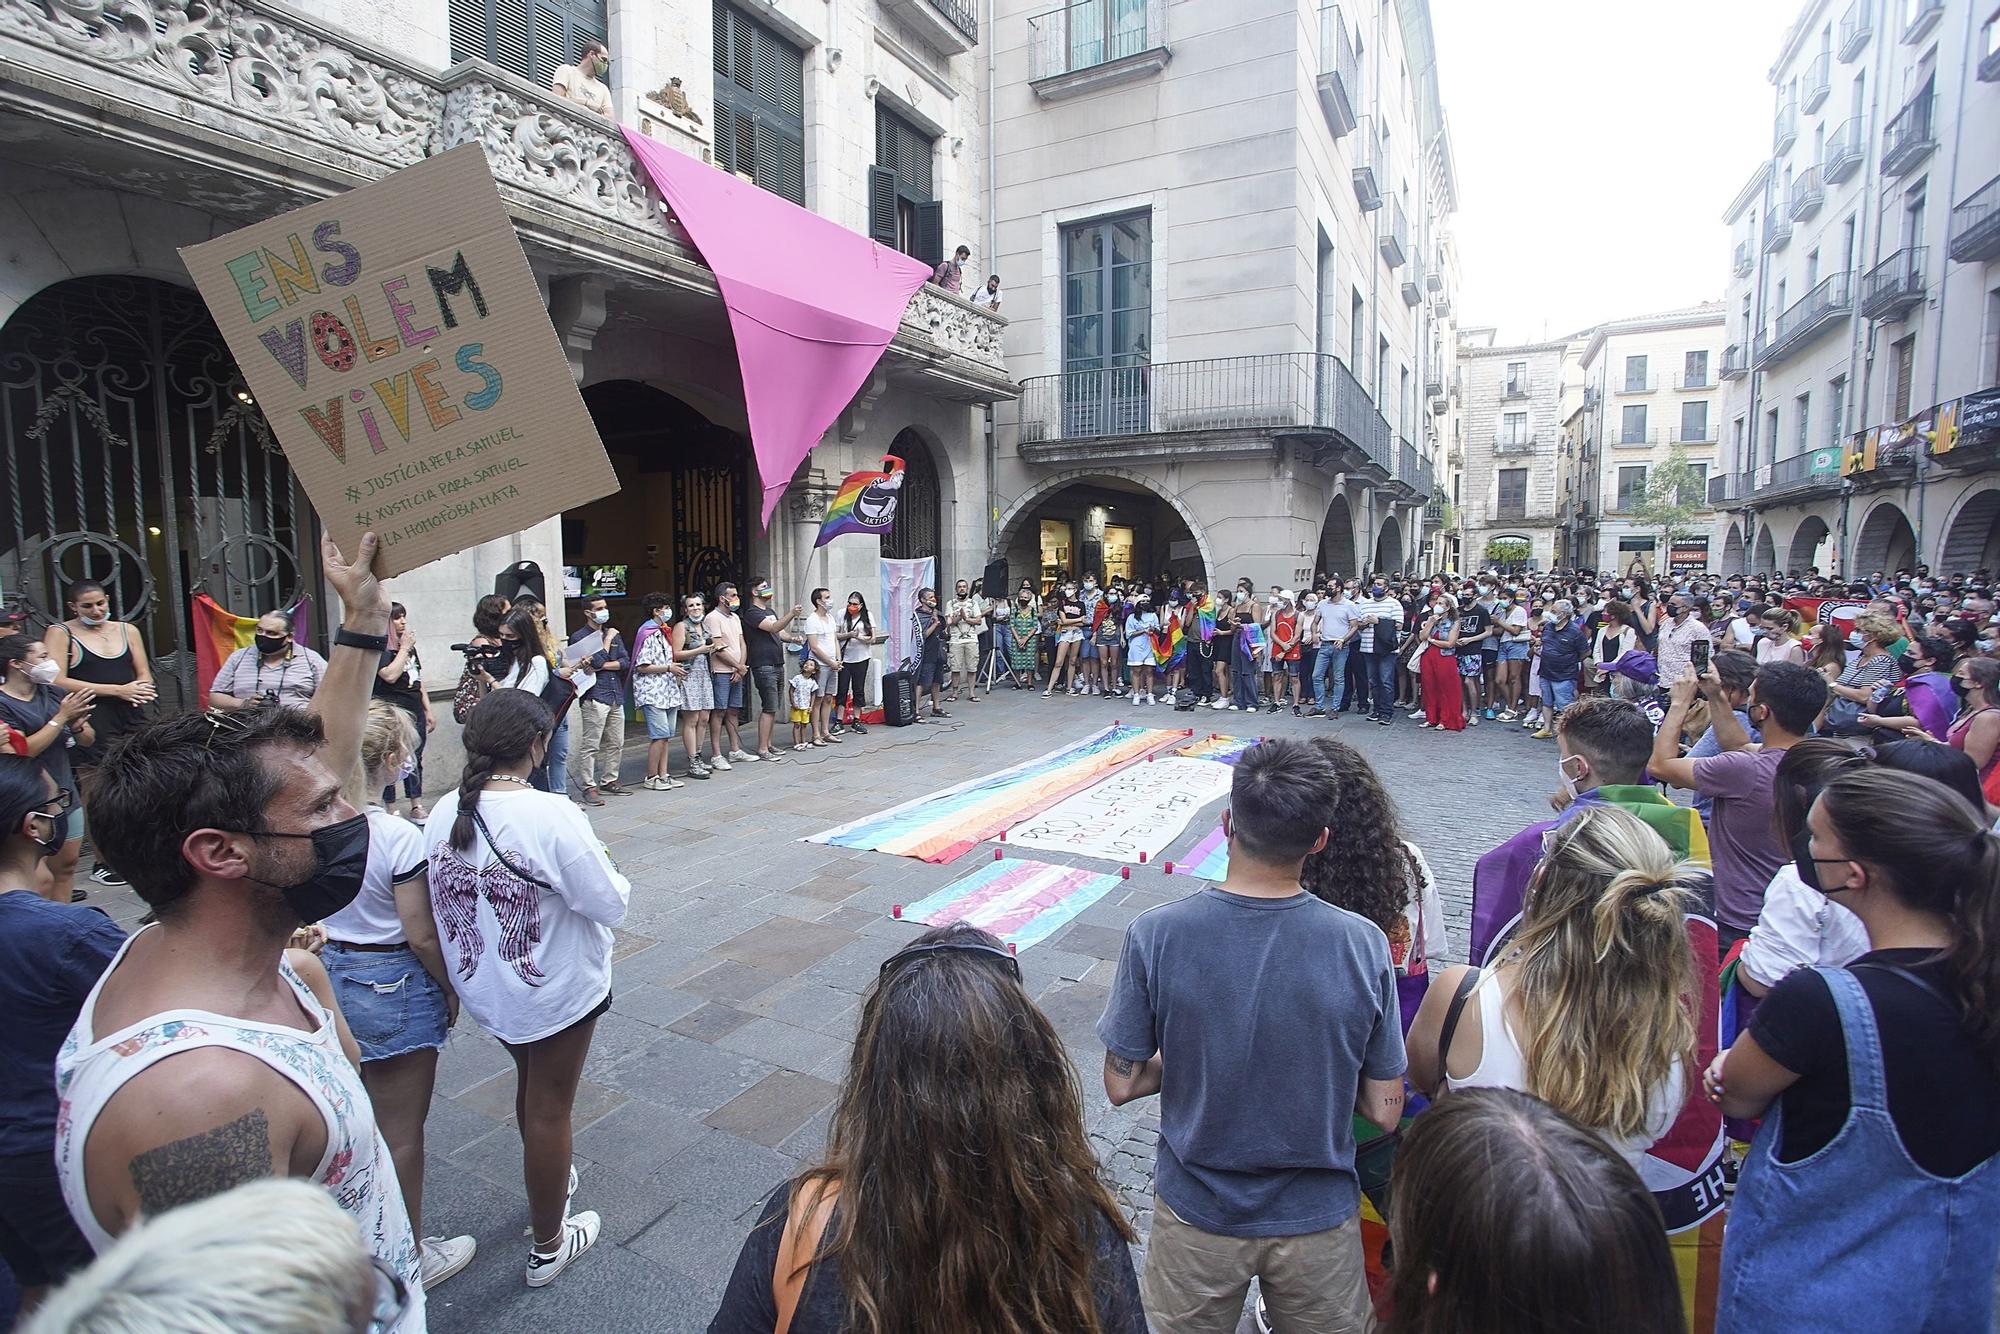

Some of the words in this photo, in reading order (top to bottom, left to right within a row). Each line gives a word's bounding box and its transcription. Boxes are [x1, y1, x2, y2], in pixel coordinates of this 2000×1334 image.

[225, 220, 362, 323] ENS
[258, 249, 490, 391] VOLEM
[384, 529, 404, 546] LA
[478, 484, 521, 510] MATA
